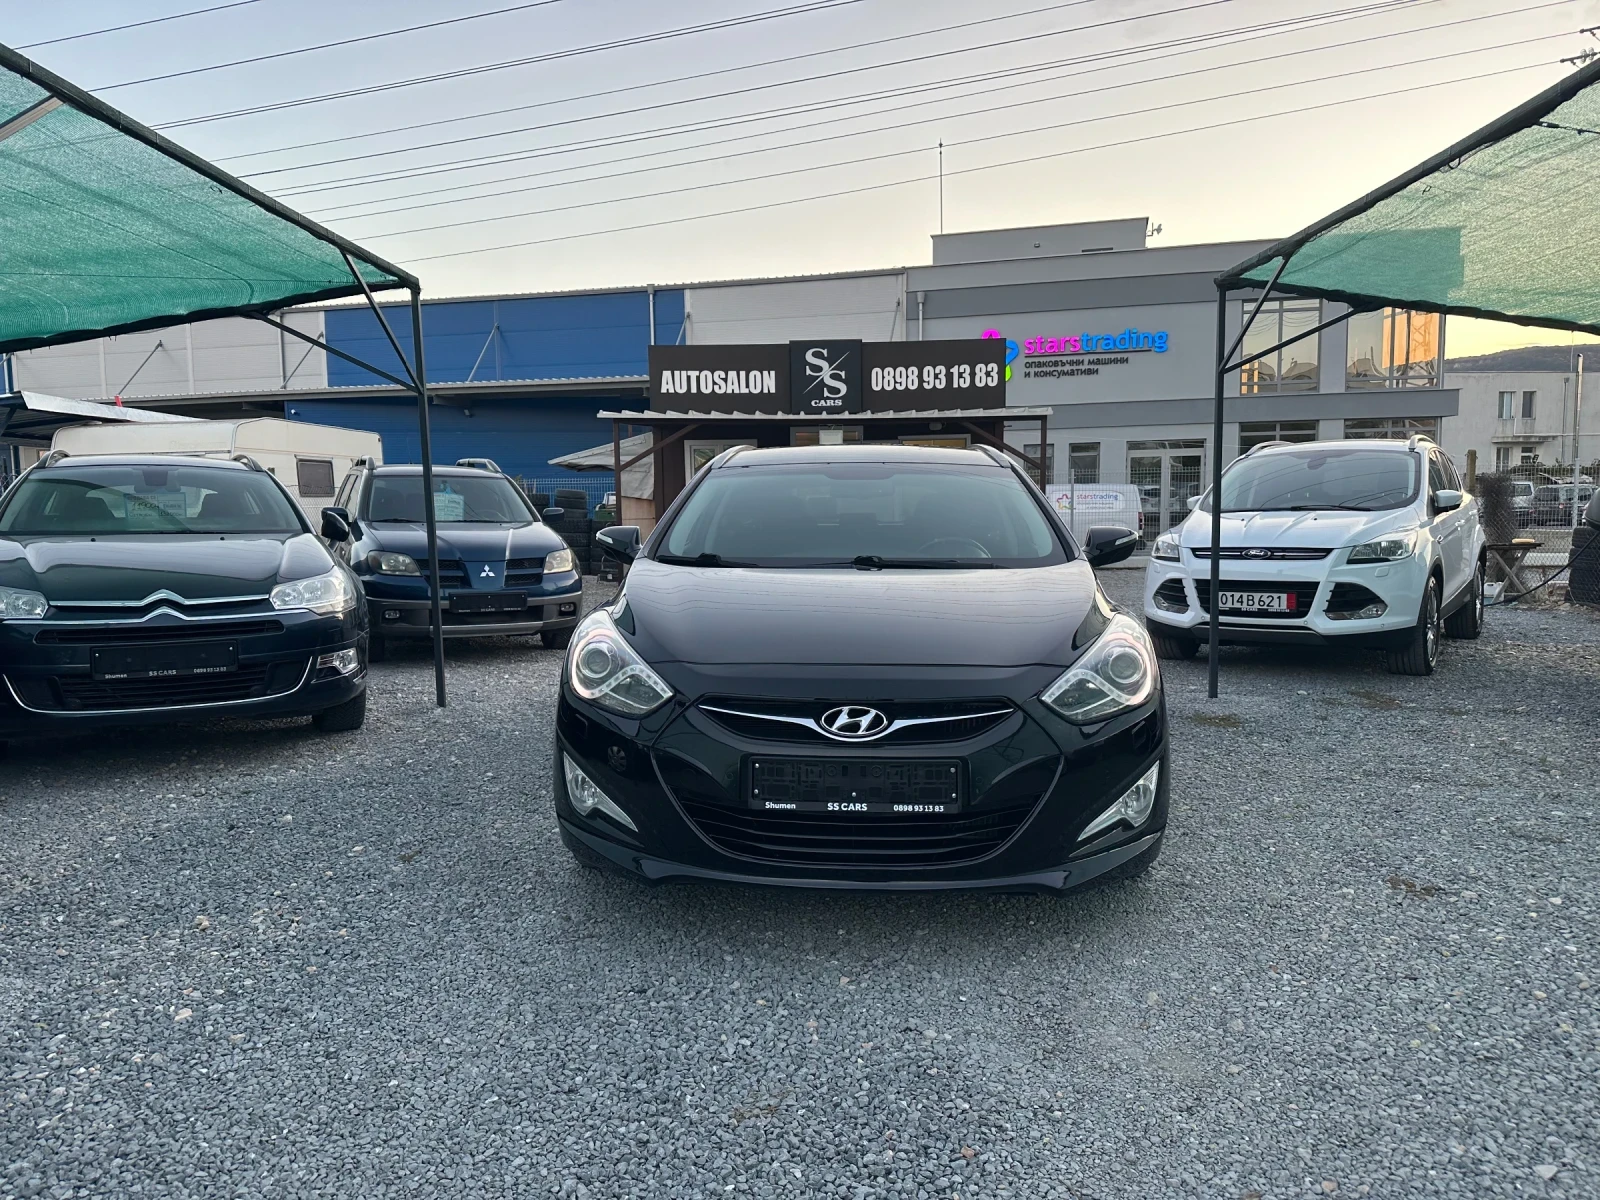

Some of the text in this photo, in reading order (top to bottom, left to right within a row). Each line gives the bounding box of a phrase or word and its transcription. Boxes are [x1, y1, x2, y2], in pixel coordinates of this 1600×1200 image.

[1023, 327, 1169, 353] starstrading
[1024, 356, 1129, 369] опаковъчни машини
[871, 362, 999, 391] 0898 93 13 83
[1024, 367, 1099, 379] и консумативи
[660, 370, 776, 394] AUTOSALON
[811, 399, 843, 407] CARS
[765, 801, 796, 809] Shumen
[827, 803, 839, 811] SS
[841, 803, 868, 811] CARS
[893, 804, 913, 812] 0898
[914, 804, 924, 812] 93
